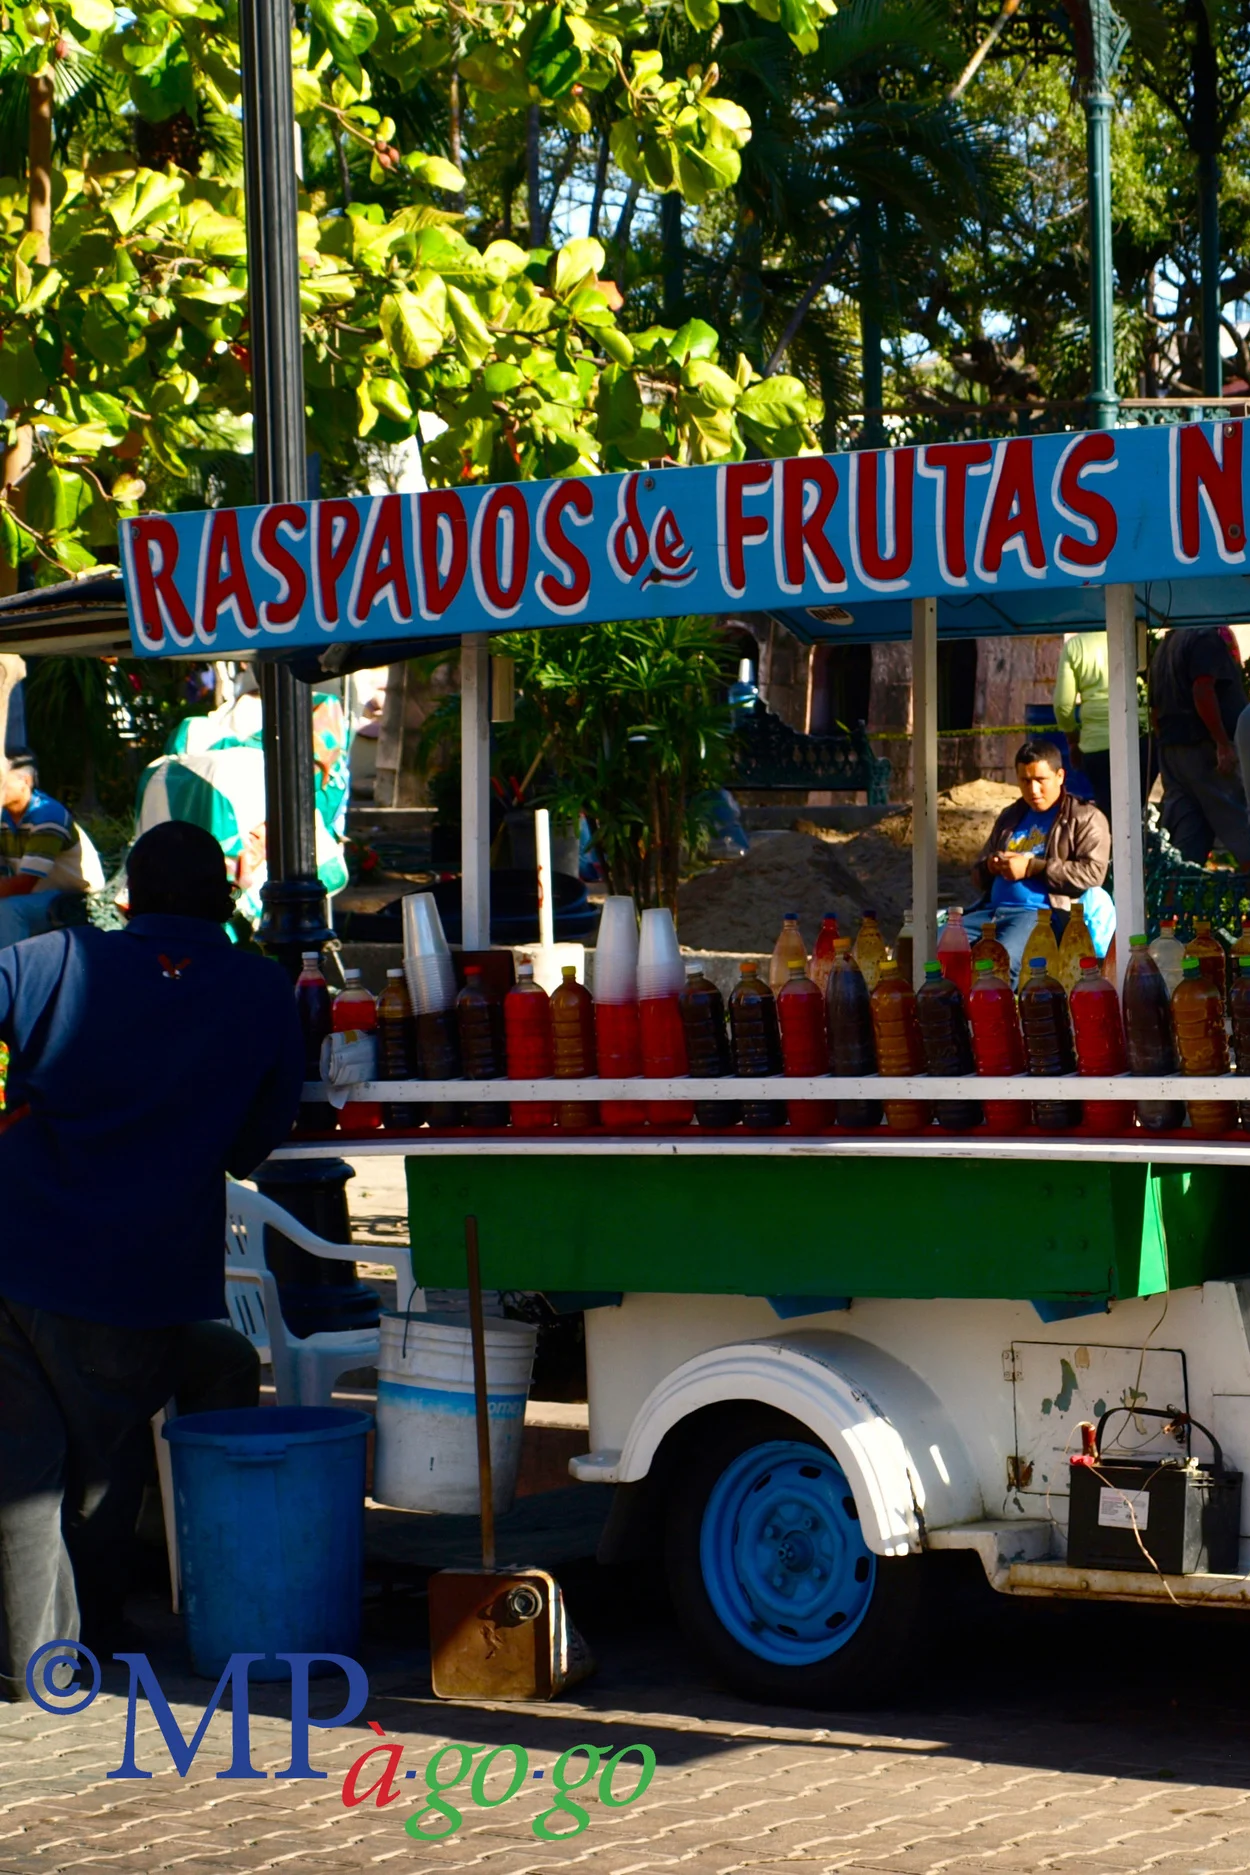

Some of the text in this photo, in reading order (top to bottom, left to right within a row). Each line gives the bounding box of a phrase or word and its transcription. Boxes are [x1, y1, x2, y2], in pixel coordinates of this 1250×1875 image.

[130, 478, 595, 651] RASPADOS
[609, 473, 698, 592] de
[717, 432, 1120, 598] FRUTAS
